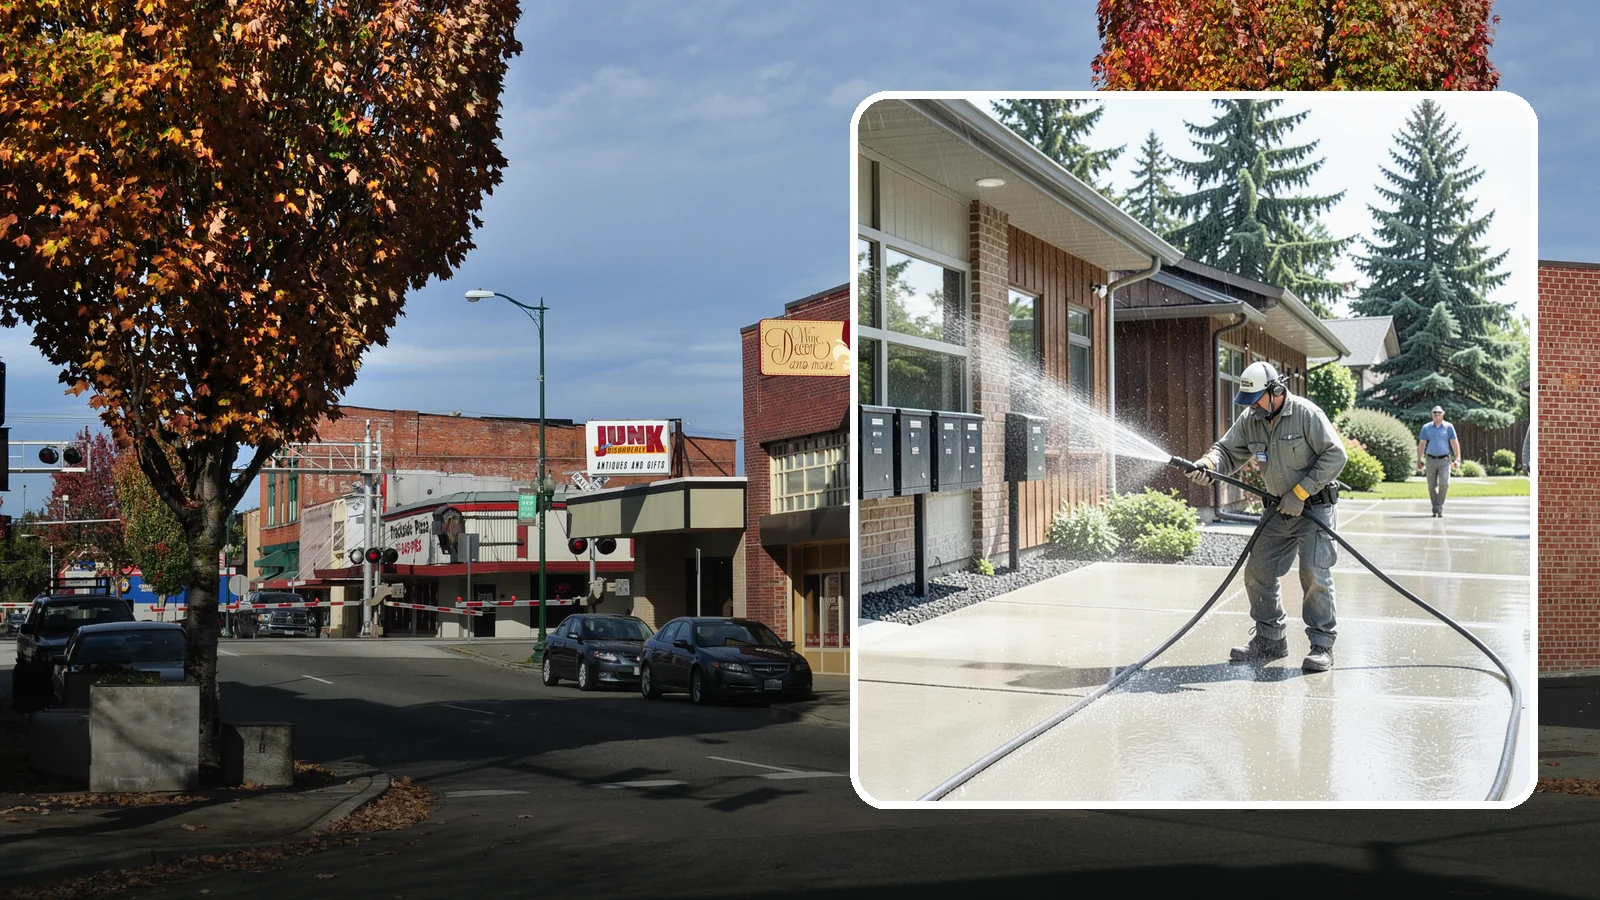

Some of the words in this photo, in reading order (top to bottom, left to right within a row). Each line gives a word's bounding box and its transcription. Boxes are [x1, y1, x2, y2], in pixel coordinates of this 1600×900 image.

[595, 425, 665, 457] JUNK
[607, 446, 646, 454] DISORDERLY
[597, 461, 628, 470] ANTIQUES
[631, 461, 644, 470] AND
[647, 460, 665, 469] GIFTS
[573, 473, 589, 492] RAIL
[590, 476, 608, 491] SING
[352, 498, 364, 511] CRO
[414, 519, 429, 535] Pizza
